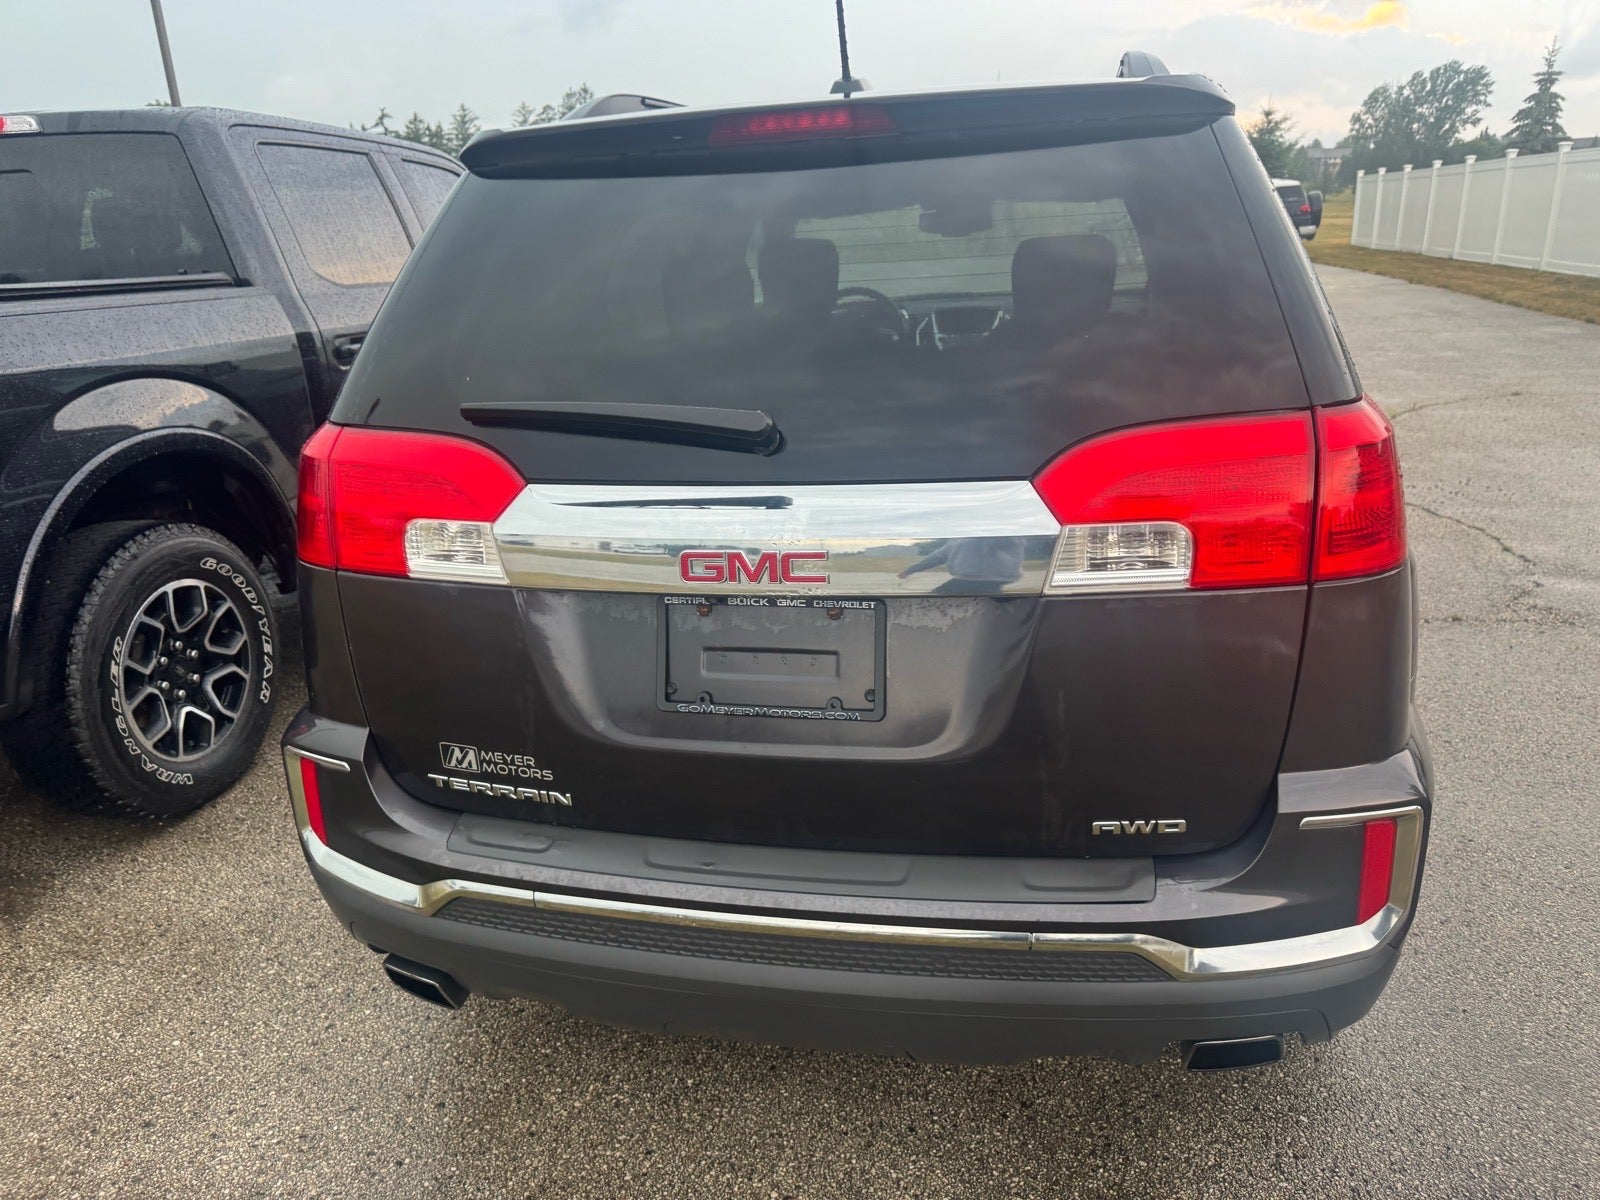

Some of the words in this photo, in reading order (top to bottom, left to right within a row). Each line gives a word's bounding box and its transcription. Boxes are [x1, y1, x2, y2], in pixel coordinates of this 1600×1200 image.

[679, 549, 830, 585] GMC
[664, 596, 720, 605] CERTIFI
[727, 597, 770, 606] BUICK
[776, 599, 807, 607] GMC
[813, 600, 877, 609] CHEVROLET
[199, 557, 274, 704] GOODYEAR
[110, 635, 194, 785] WRANGLER
[480, 750, 536, 767] MEYER
[482, 763, 554, 781] MOTORS
[427, 773, 573, 806] TERRAIN
[1091, 819, 1187, 836] AWD
